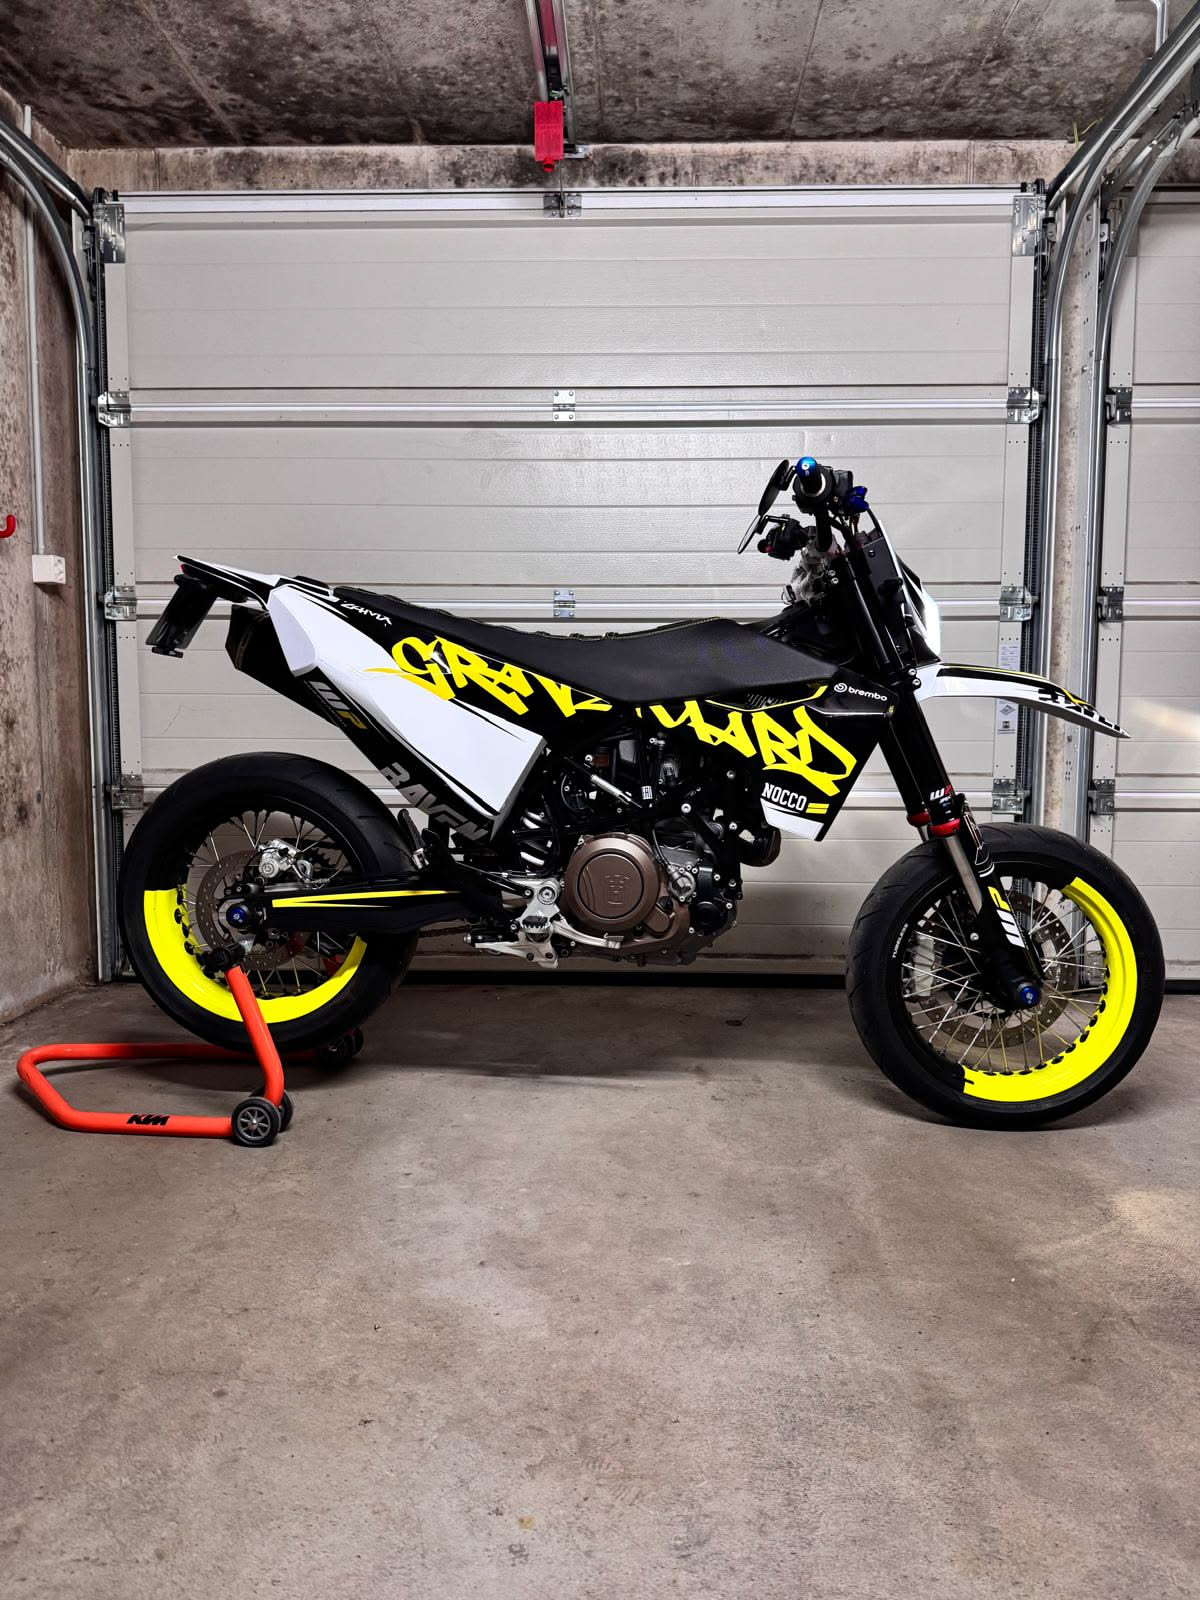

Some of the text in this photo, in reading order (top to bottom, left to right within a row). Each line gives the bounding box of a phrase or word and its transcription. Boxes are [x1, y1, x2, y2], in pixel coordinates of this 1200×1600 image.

[848, 686, 888, 701] brembo
[761, 782, 807, 811] NOCCO
[127, 1114, 170, 1126] KTM
